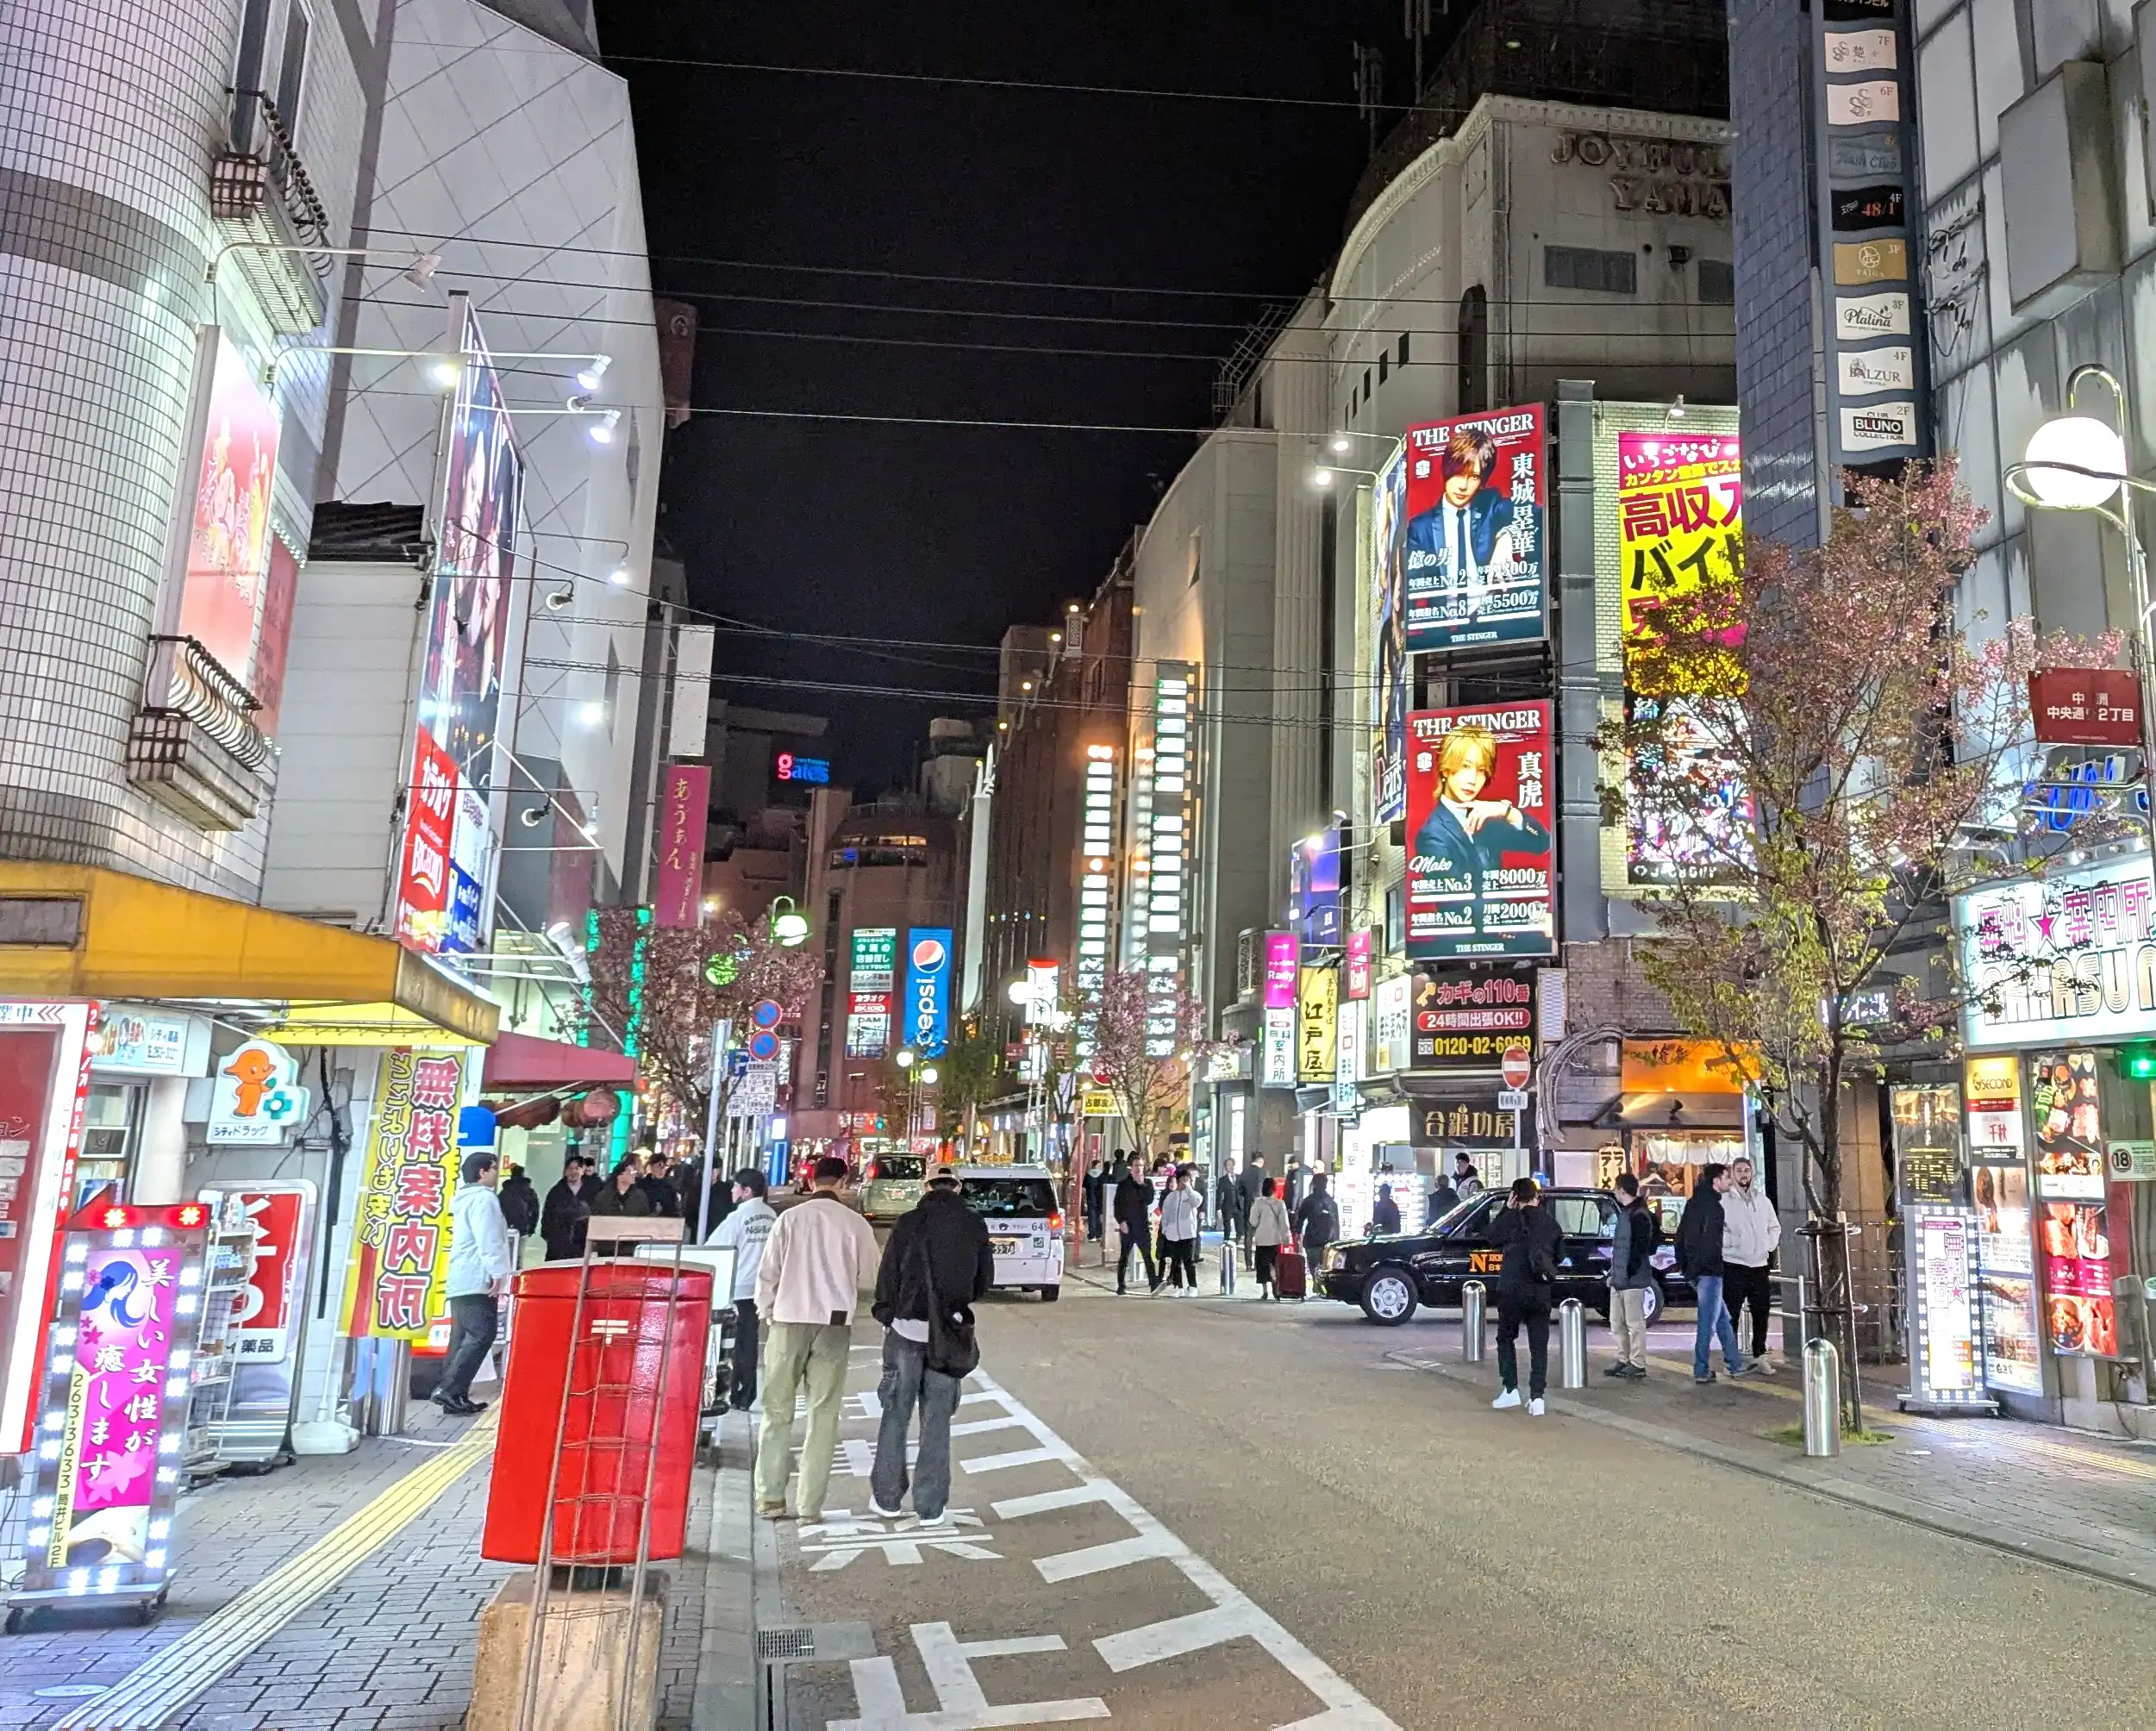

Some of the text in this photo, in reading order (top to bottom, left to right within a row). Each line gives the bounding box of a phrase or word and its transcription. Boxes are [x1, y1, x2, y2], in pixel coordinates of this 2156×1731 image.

[1880, 86, 1893, 97] 6F
[1890, 192, 1902, 203] 4F
[1888, 244, 1901, 254] 3F
[1844, 307, 1893, 328] Platina
[1854, 418, 1902, 432] BLUNO
[1412, 426, 1450, 447] THE
[1623, 438, 1722, 470] いちごなび
[1450, 631, 1498, 643] THE STINGER
[1412, 716, 1452, 738] THE
[421, 755, 453, 822] カラオケ
[1516, 750, 1544, 809] 真虎
[1455, 942, 1505, 953] THE STINGER
[1436, 978, 1531, 1006] カギの110番
[1427, 1010, 1524, 1028] 24時間出張OK!!
[214, 1125, 269, 1138] シティドラッグ
[2113, 1152, 2129, 1167] 18
[122, 1259, 175, 1453] 美しい女性が
[79, 1344, 127, 1483] 癒します
